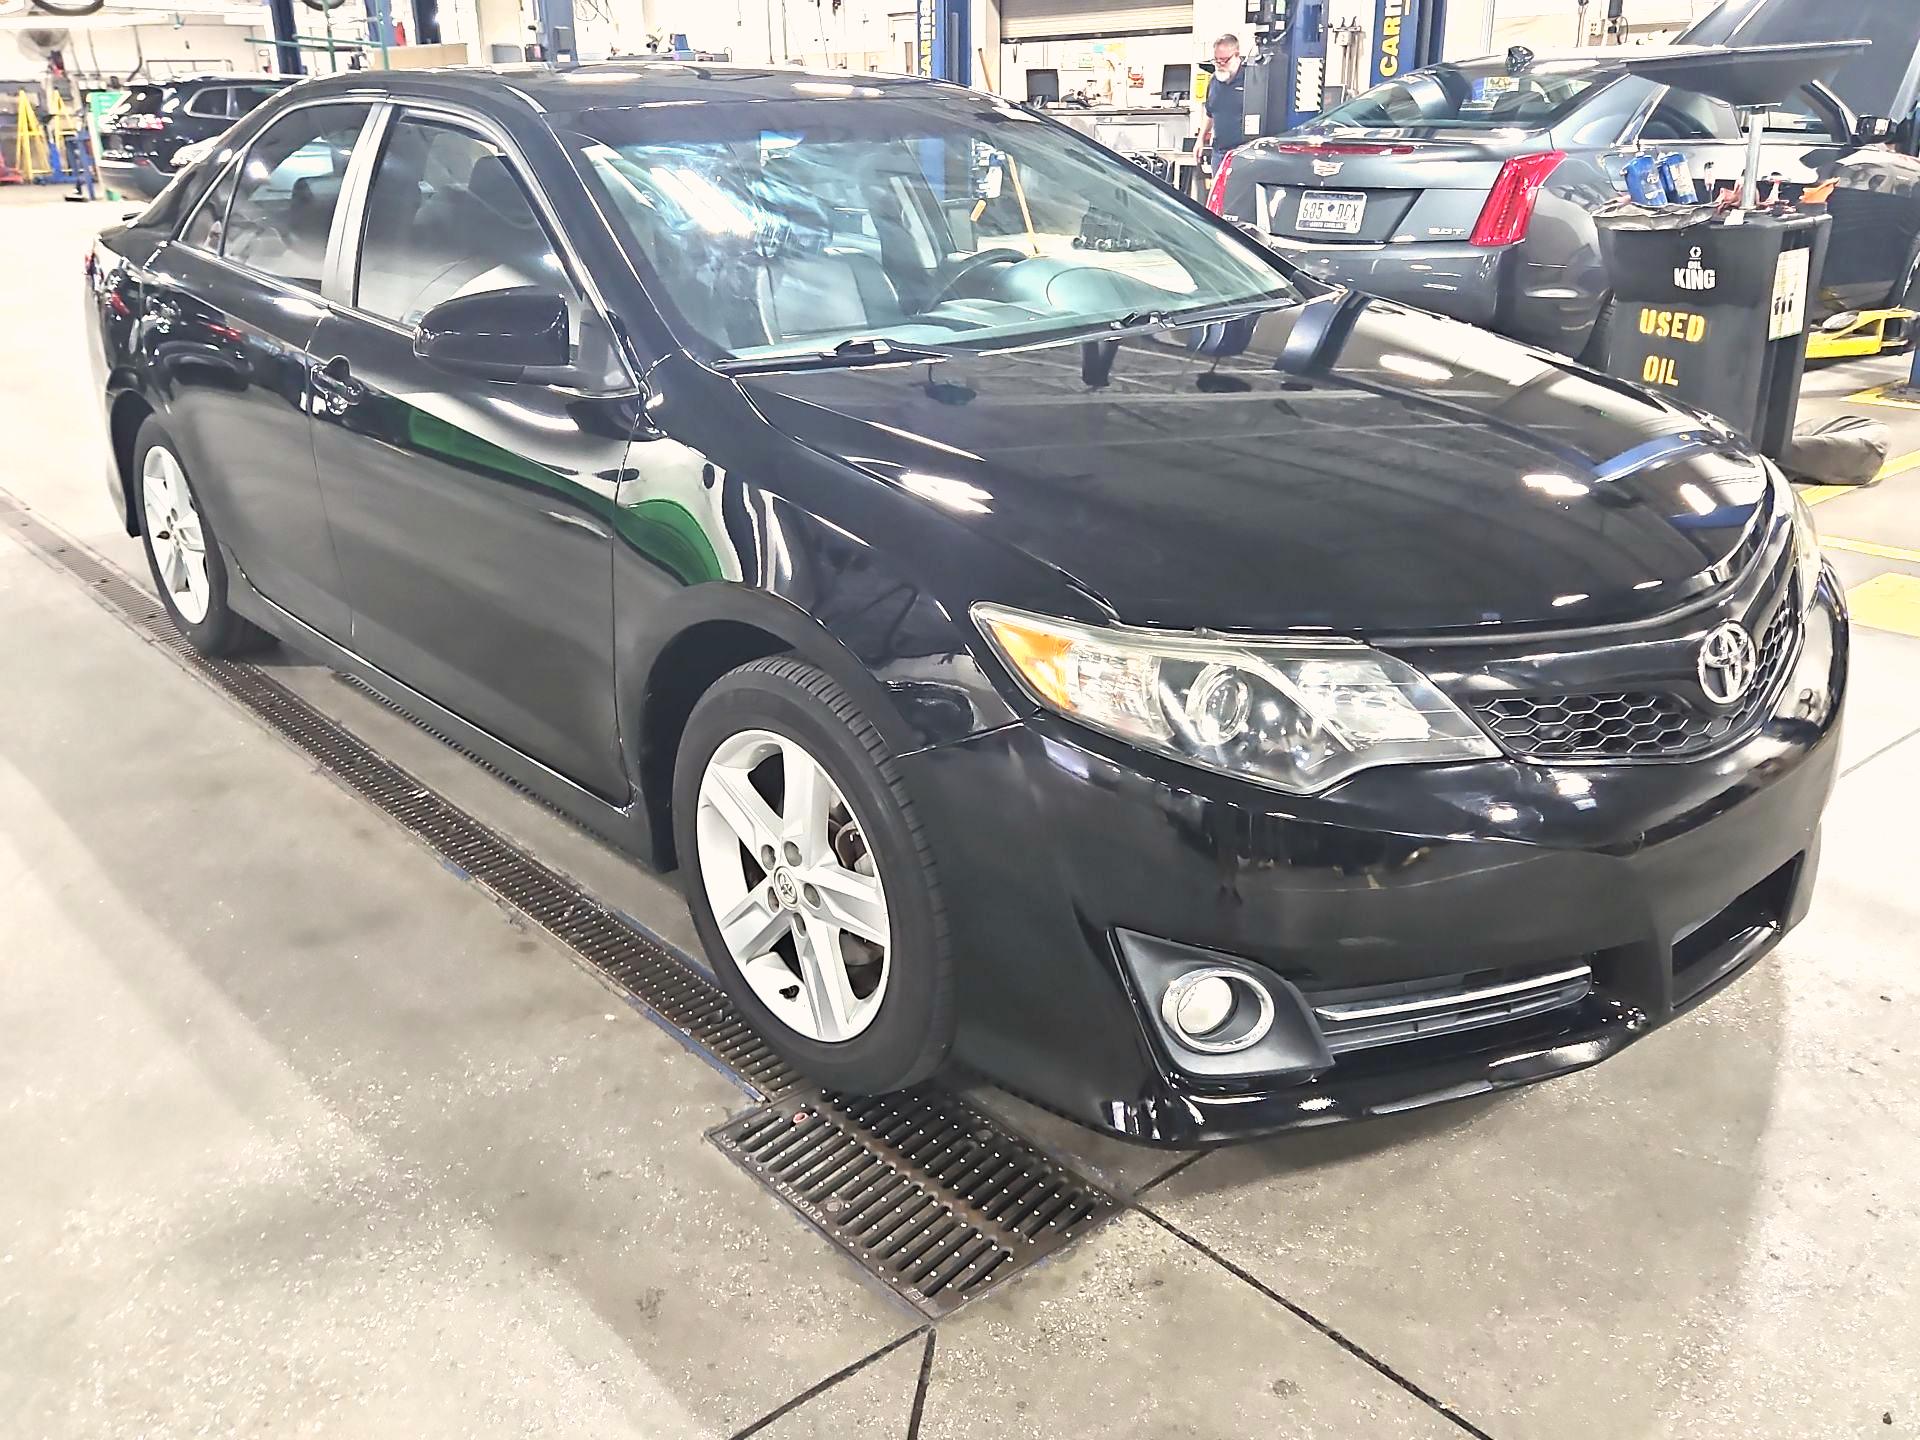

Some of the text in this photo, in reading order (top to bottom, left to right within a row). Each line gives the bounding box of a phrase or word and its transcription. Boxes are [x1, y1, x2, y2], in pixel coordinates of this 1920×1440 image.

[1673, 267, 1716, 290] KING
[1639, 308, 1706, 343] USED
[1642, 355, 1679, 387] OIL
